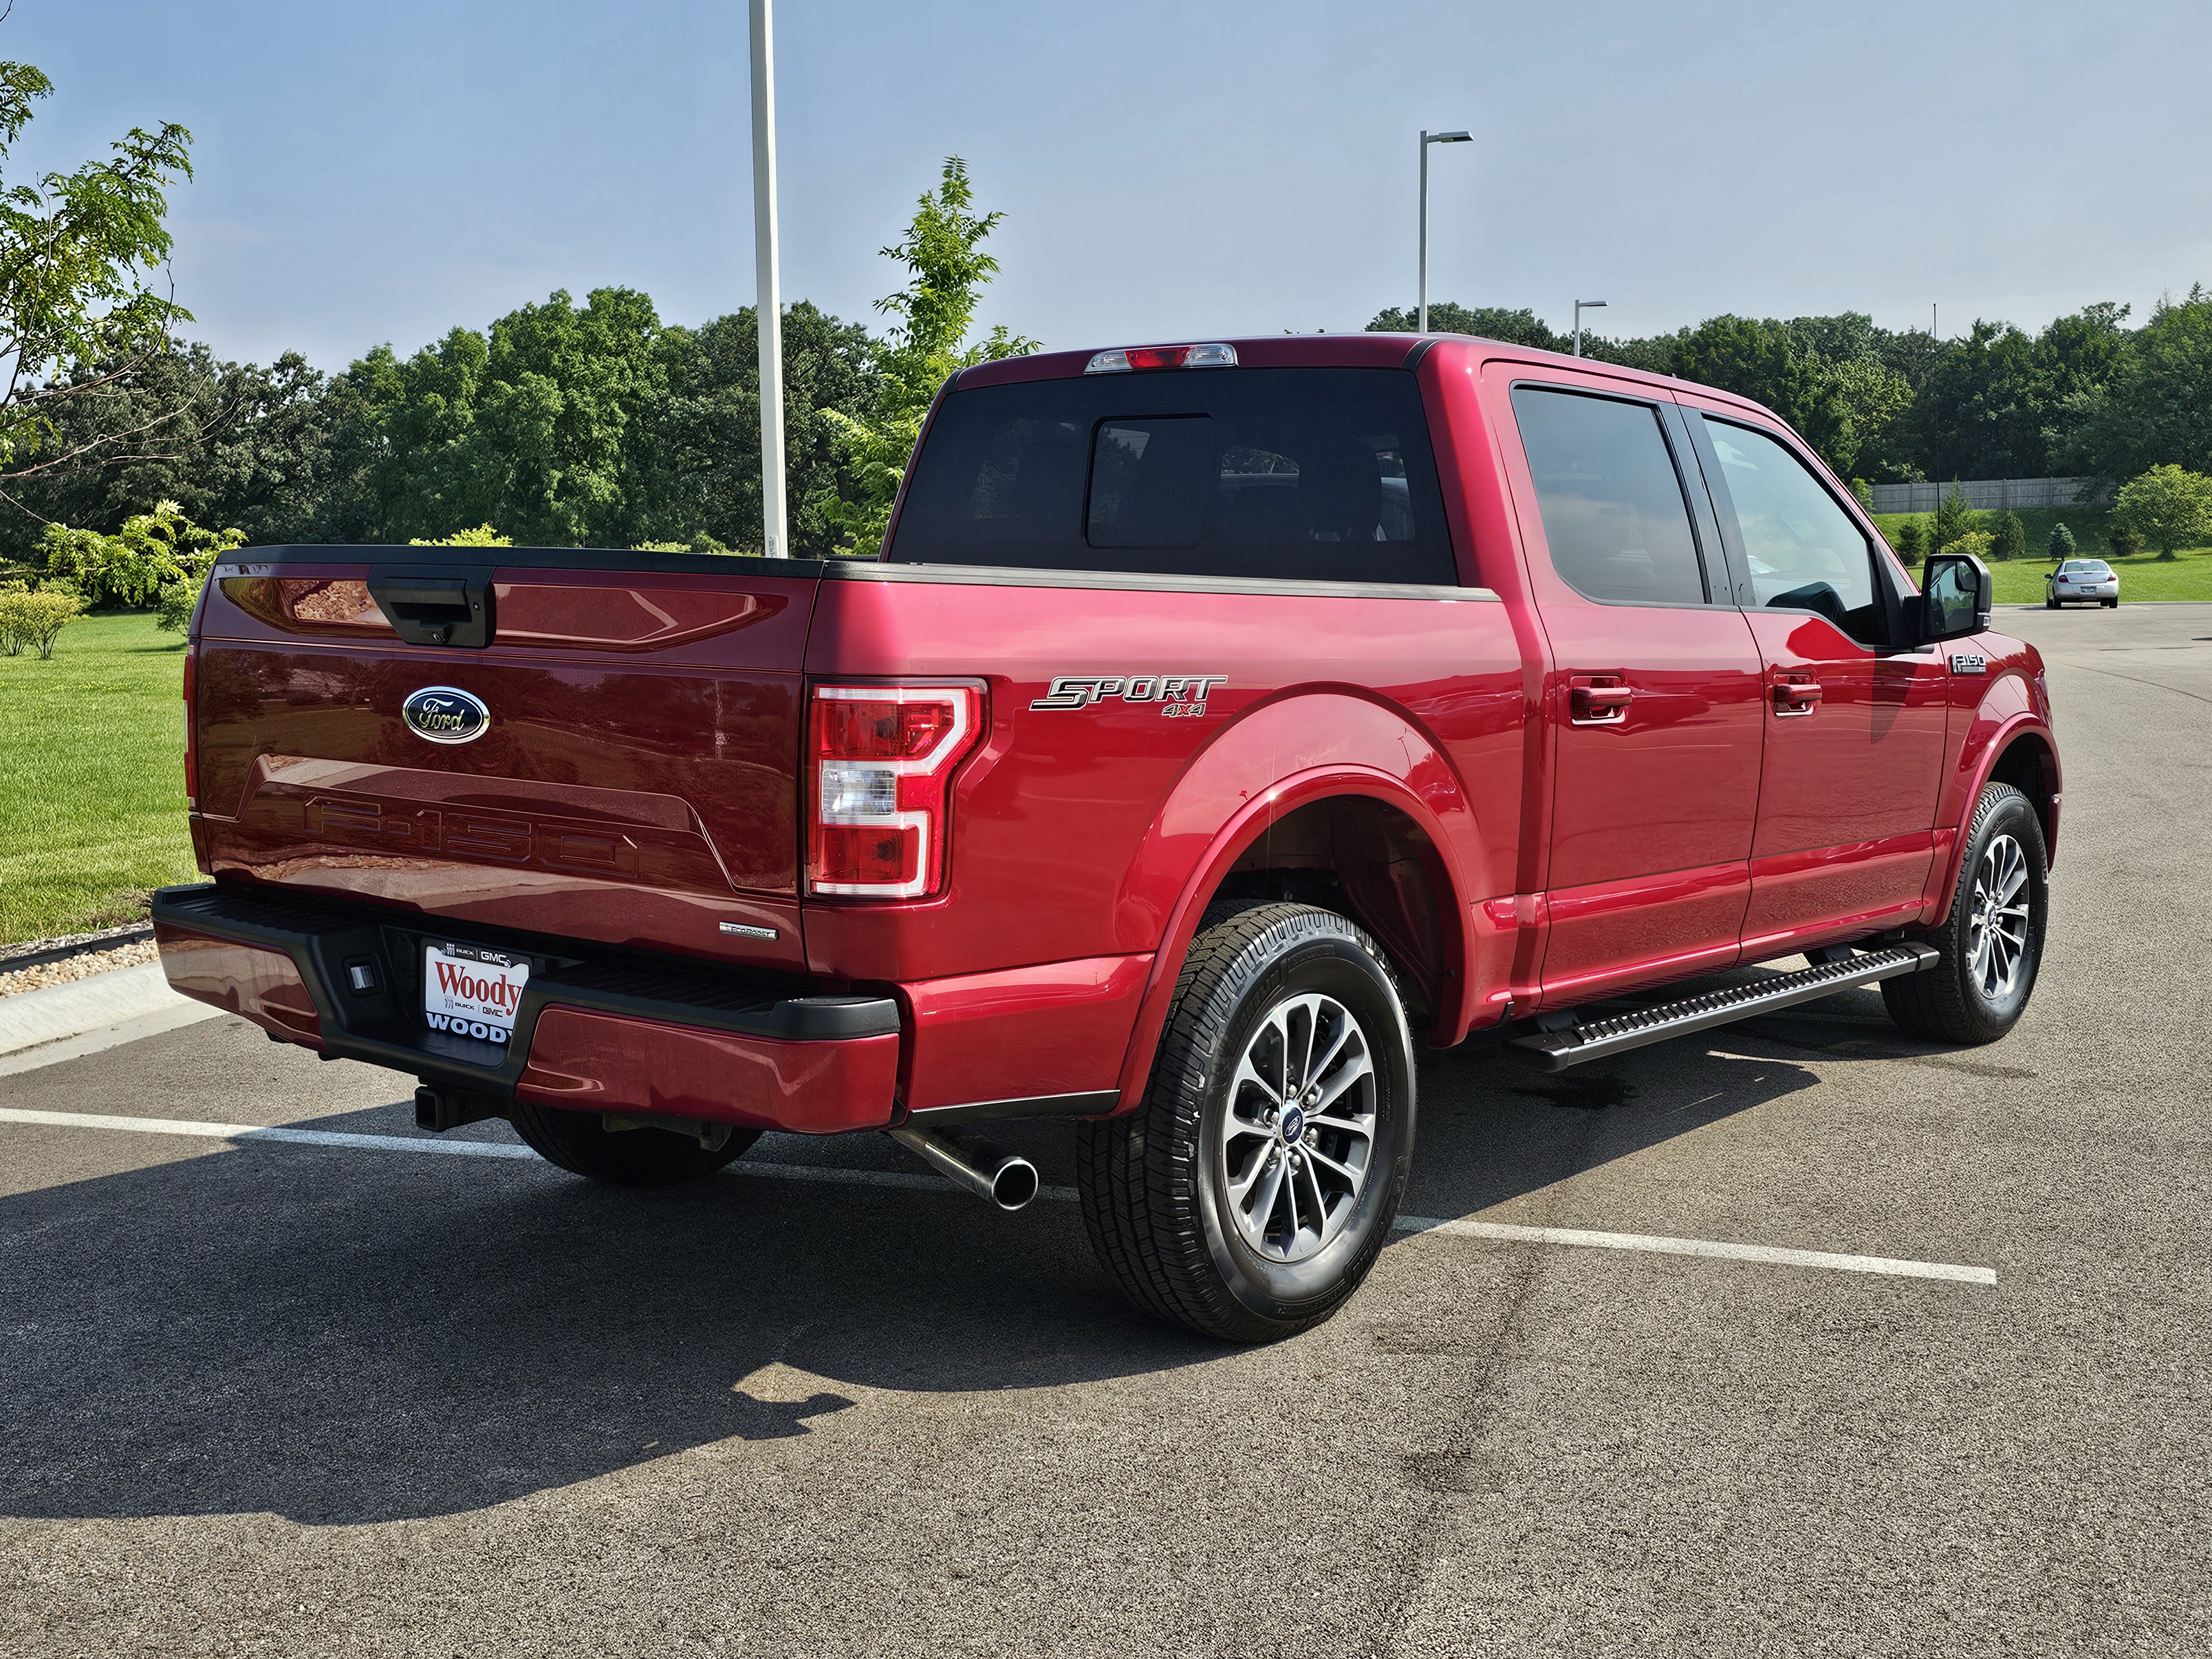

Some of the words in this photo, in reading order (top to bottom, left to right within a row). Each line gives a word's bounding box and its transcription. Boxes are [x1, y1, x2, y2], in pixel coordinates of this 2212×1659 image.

[1029, 675, 1228, 711] SPORT
[419, 698, 465, 731] Ford
[481, 951, 507, 963] GMC
[435, 961, 523, 1016] Woody
